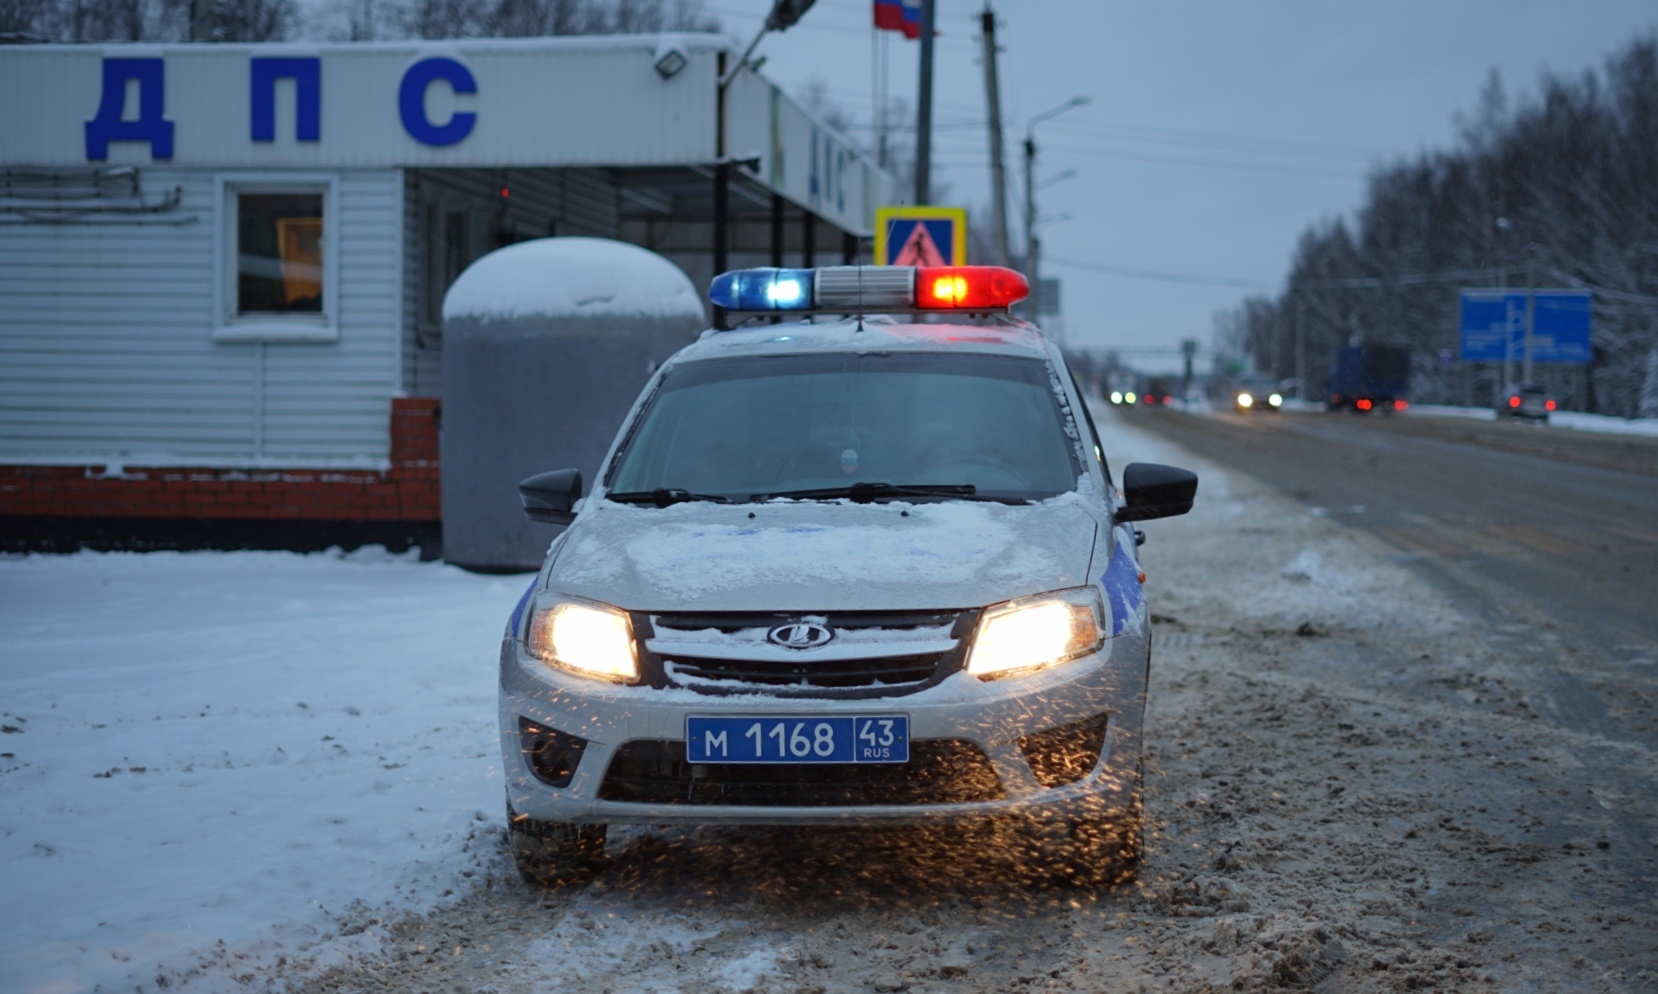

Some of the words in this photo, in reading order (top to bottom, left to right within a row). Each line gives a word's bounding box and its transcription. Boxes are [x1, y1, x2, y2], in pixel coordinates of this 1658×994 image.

[85, 57, 478, 160] ДПС
[705, 730, 728, 757] М
[745, 722, 835, 757] 1168
[859, 720, 894, 747] 43
[863, 748, 890, 758] RUS
